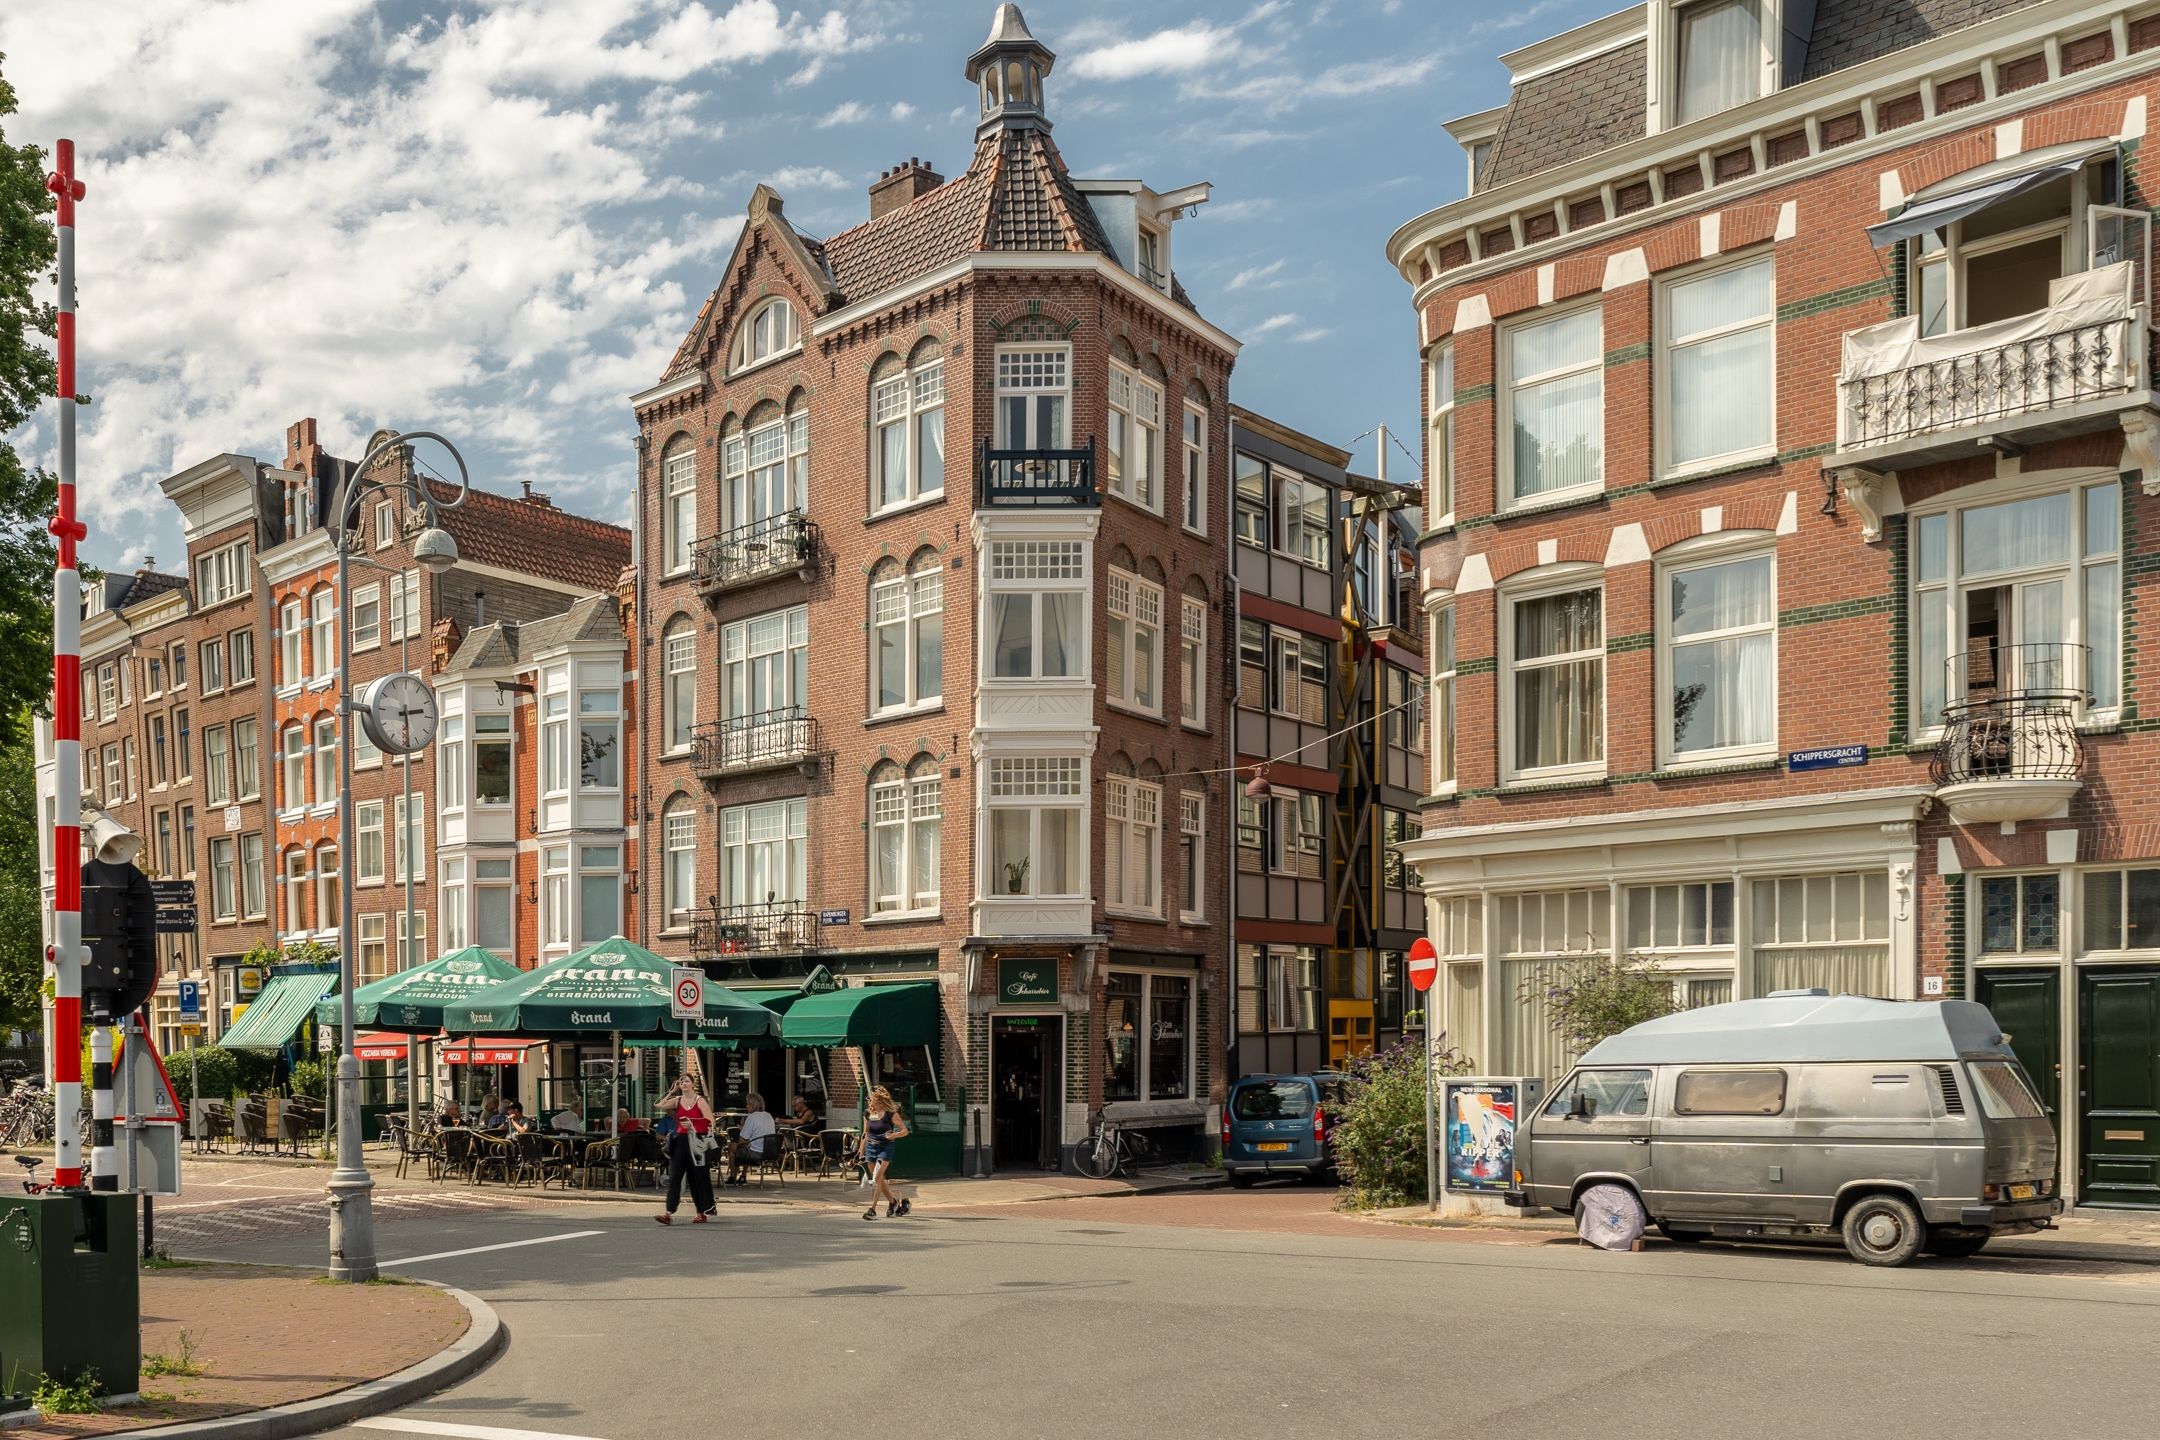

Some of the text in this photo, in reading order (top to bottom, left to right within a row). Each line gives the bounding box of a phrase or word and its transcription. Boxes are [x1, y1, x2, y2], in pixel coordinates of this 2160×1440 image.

[1792, 747, 1863, 762] SCHIPPERSGRACHT
[1837, 756, 1863, 764] CENTRUM
[541, 968, 664, 985] Brand
[812, 980, 836, 990] Brand
[1927, 981, 1938, 991] 16
[183, 984, 194, 1001] P
[681, 988, 696, 999] 30
[469, 1011, 494, 1024] Brand
[571, 1010, 612, 1025] Brand
[695, 1016, 729, 1028] Brand
[1461, 1148, 1500, 1157] RIPPER
